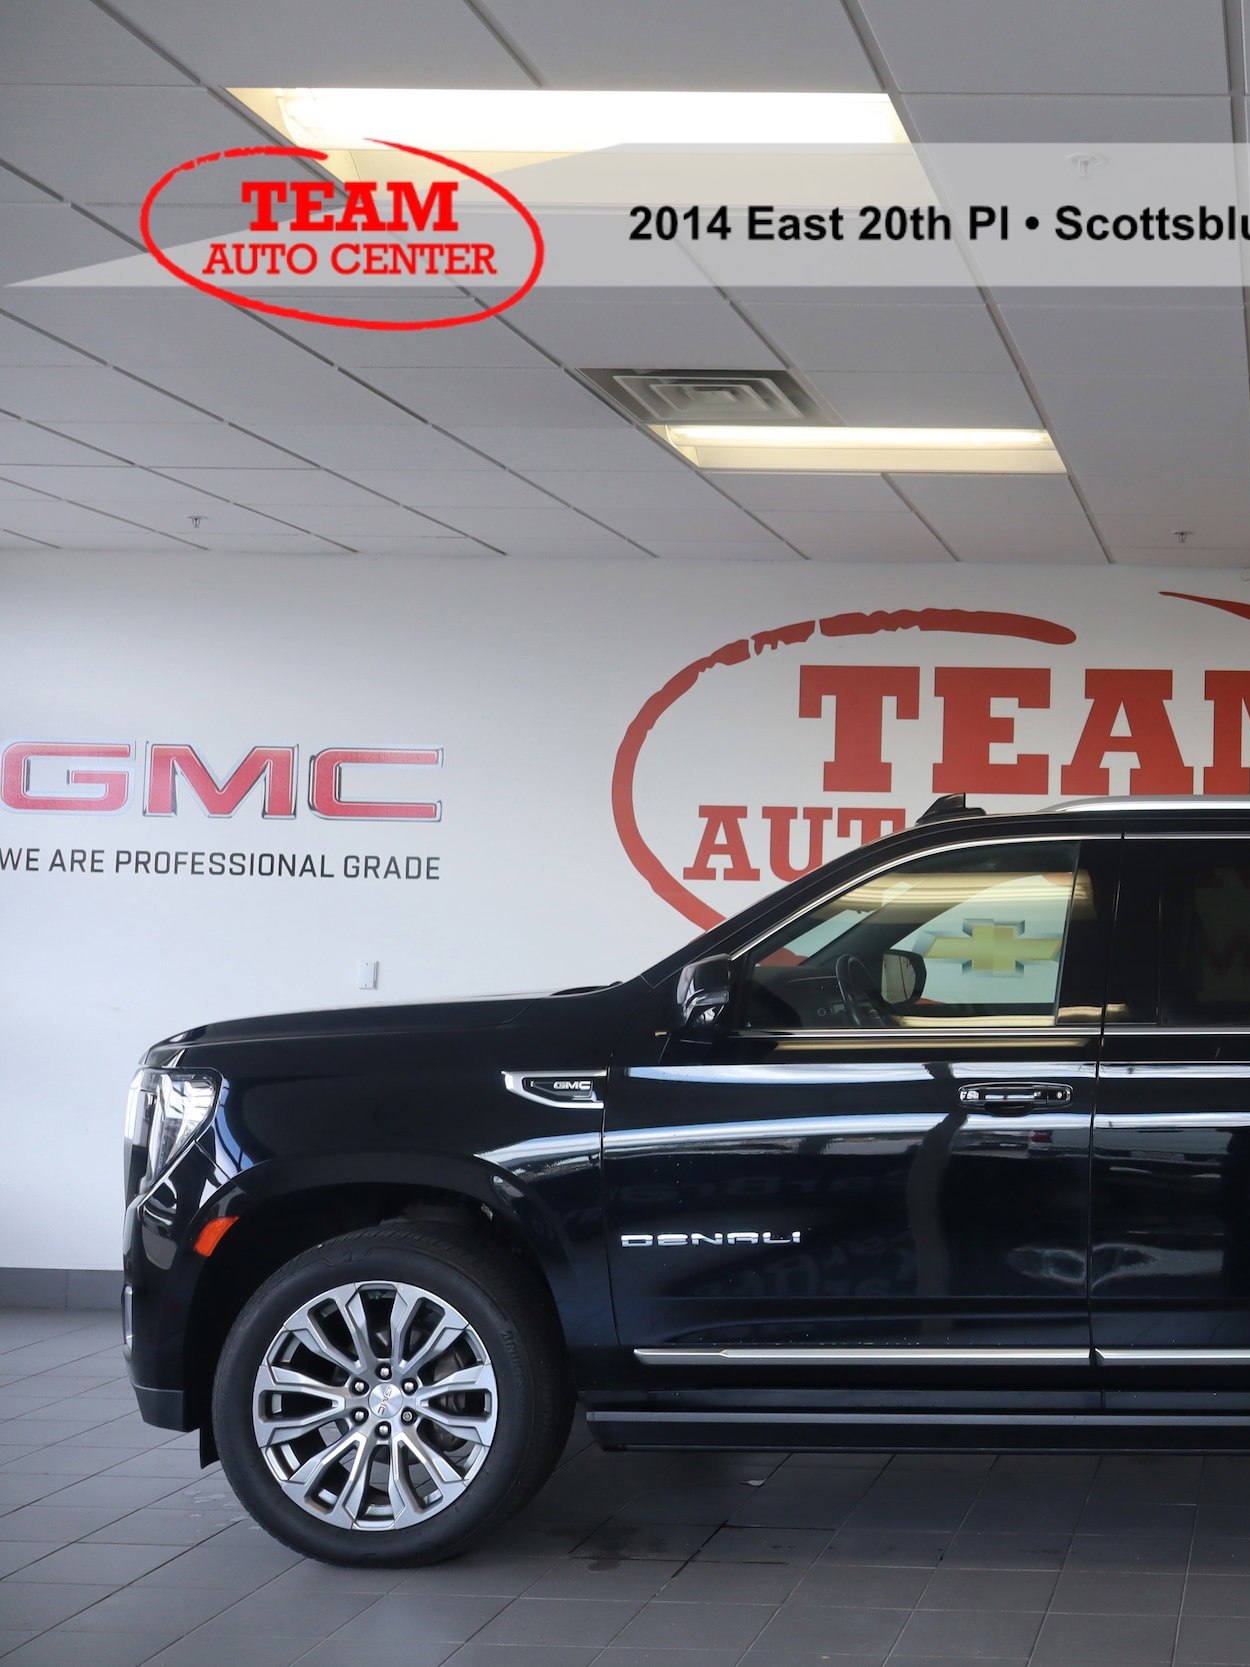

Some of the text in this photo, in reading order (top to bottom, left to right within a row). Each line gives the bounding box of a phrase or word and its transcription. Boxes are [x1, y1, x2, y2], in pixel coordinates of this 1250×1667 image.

[0, 738, 444, 823] GMC
[0, 847, 441, 880] WE ARE PROFESSIONAL GRADE
[553, 1080, 591, 1090] GMC
[621, 1230, 801, 1248] DENALI
[377, 1386, 393, 1415] GMC
